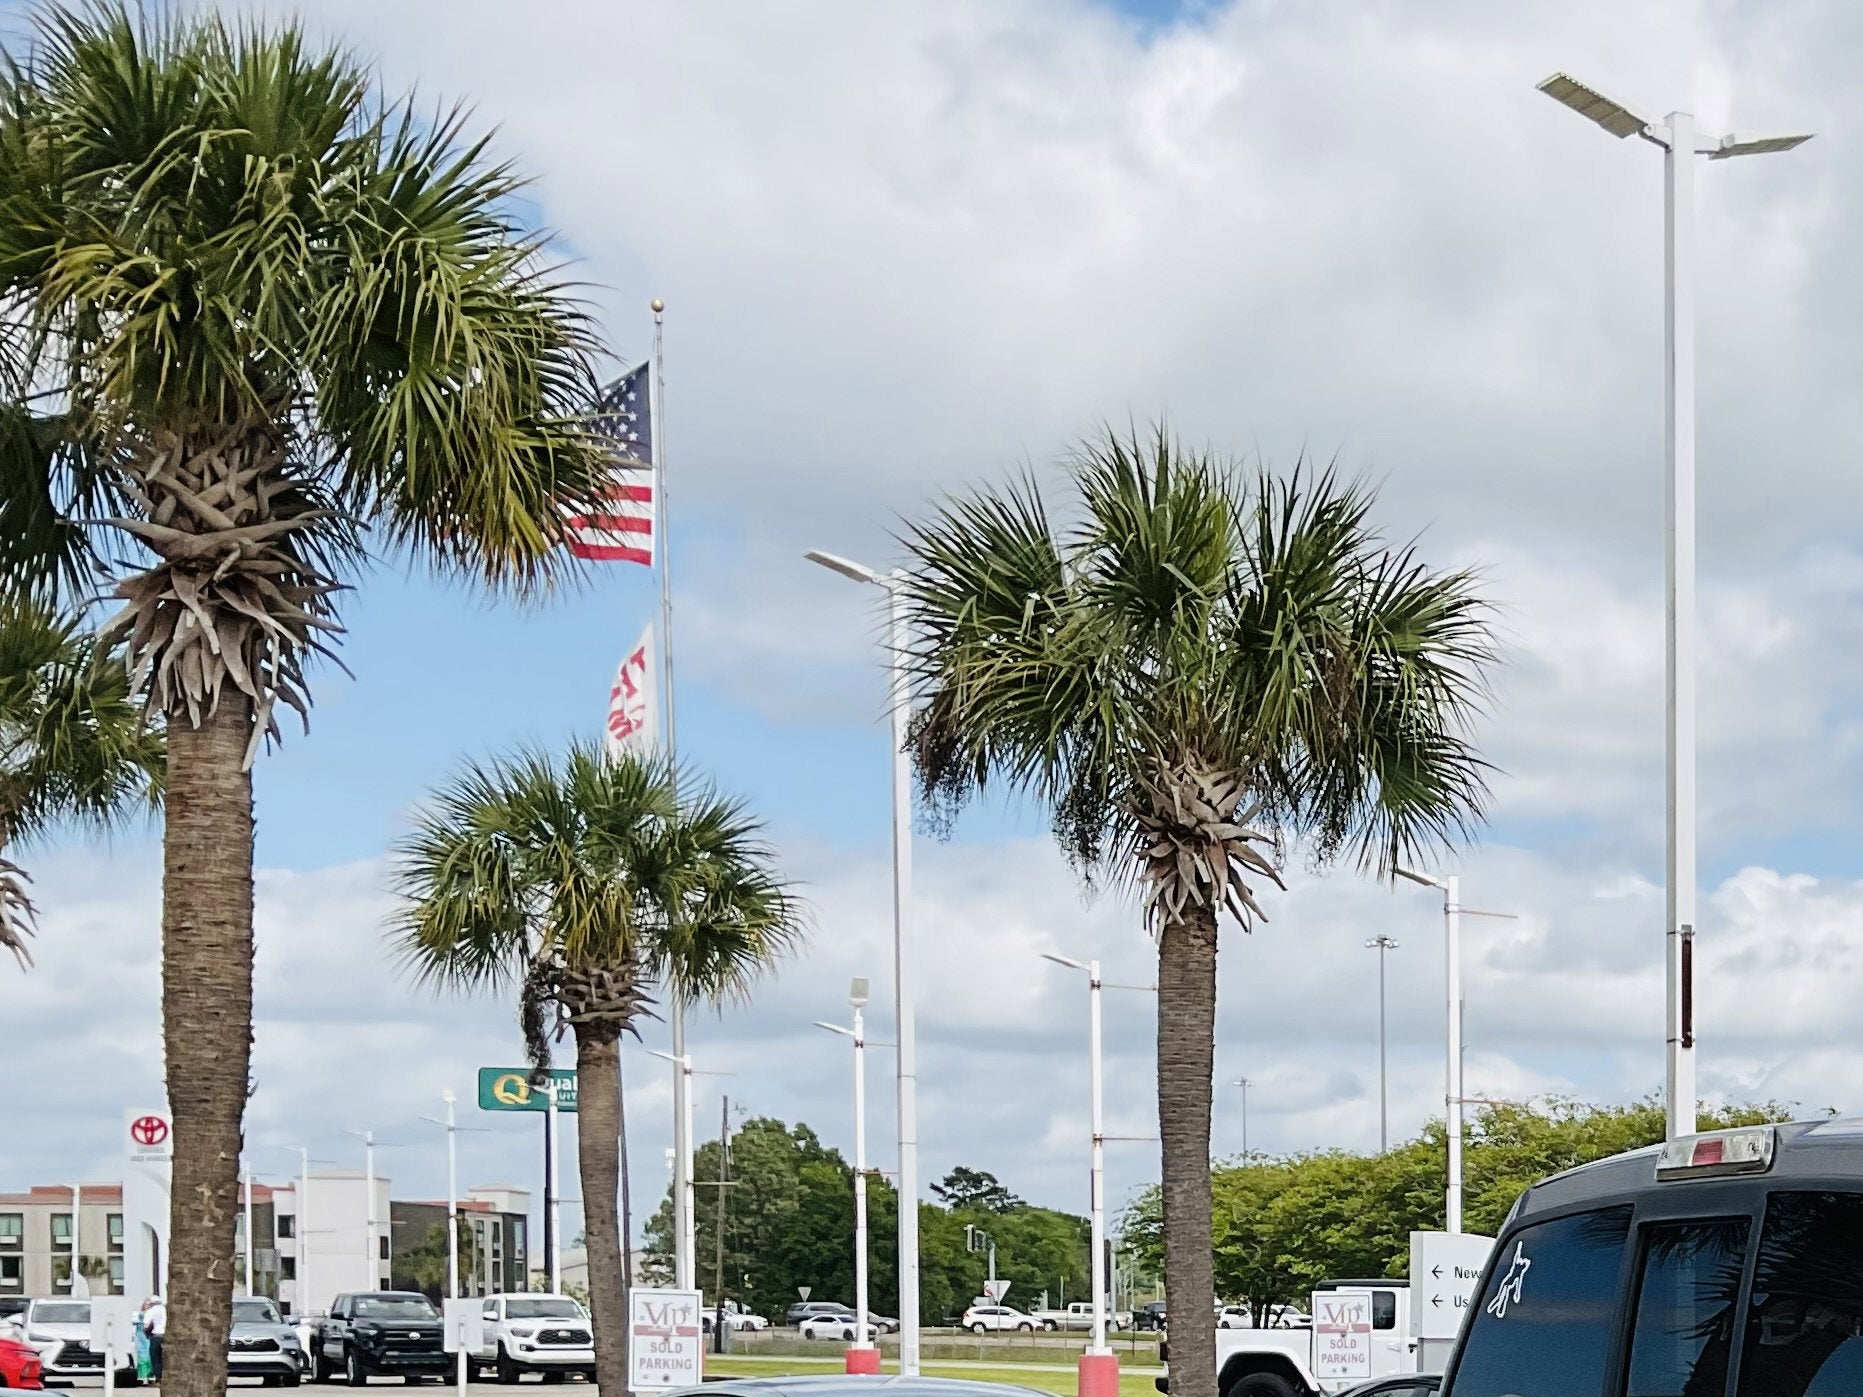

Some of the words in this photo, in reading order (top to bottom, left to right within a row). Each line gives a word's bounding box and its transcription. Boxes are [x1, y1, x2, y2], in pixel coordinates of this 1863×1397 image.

[650, 1342, 683, 1354] SOLD
[1329, 1339, 1357, 1349] SOLD
[639, 1357, 692, 1370] PARKING
[1321, 1353, 1365, 1364] PARKING
